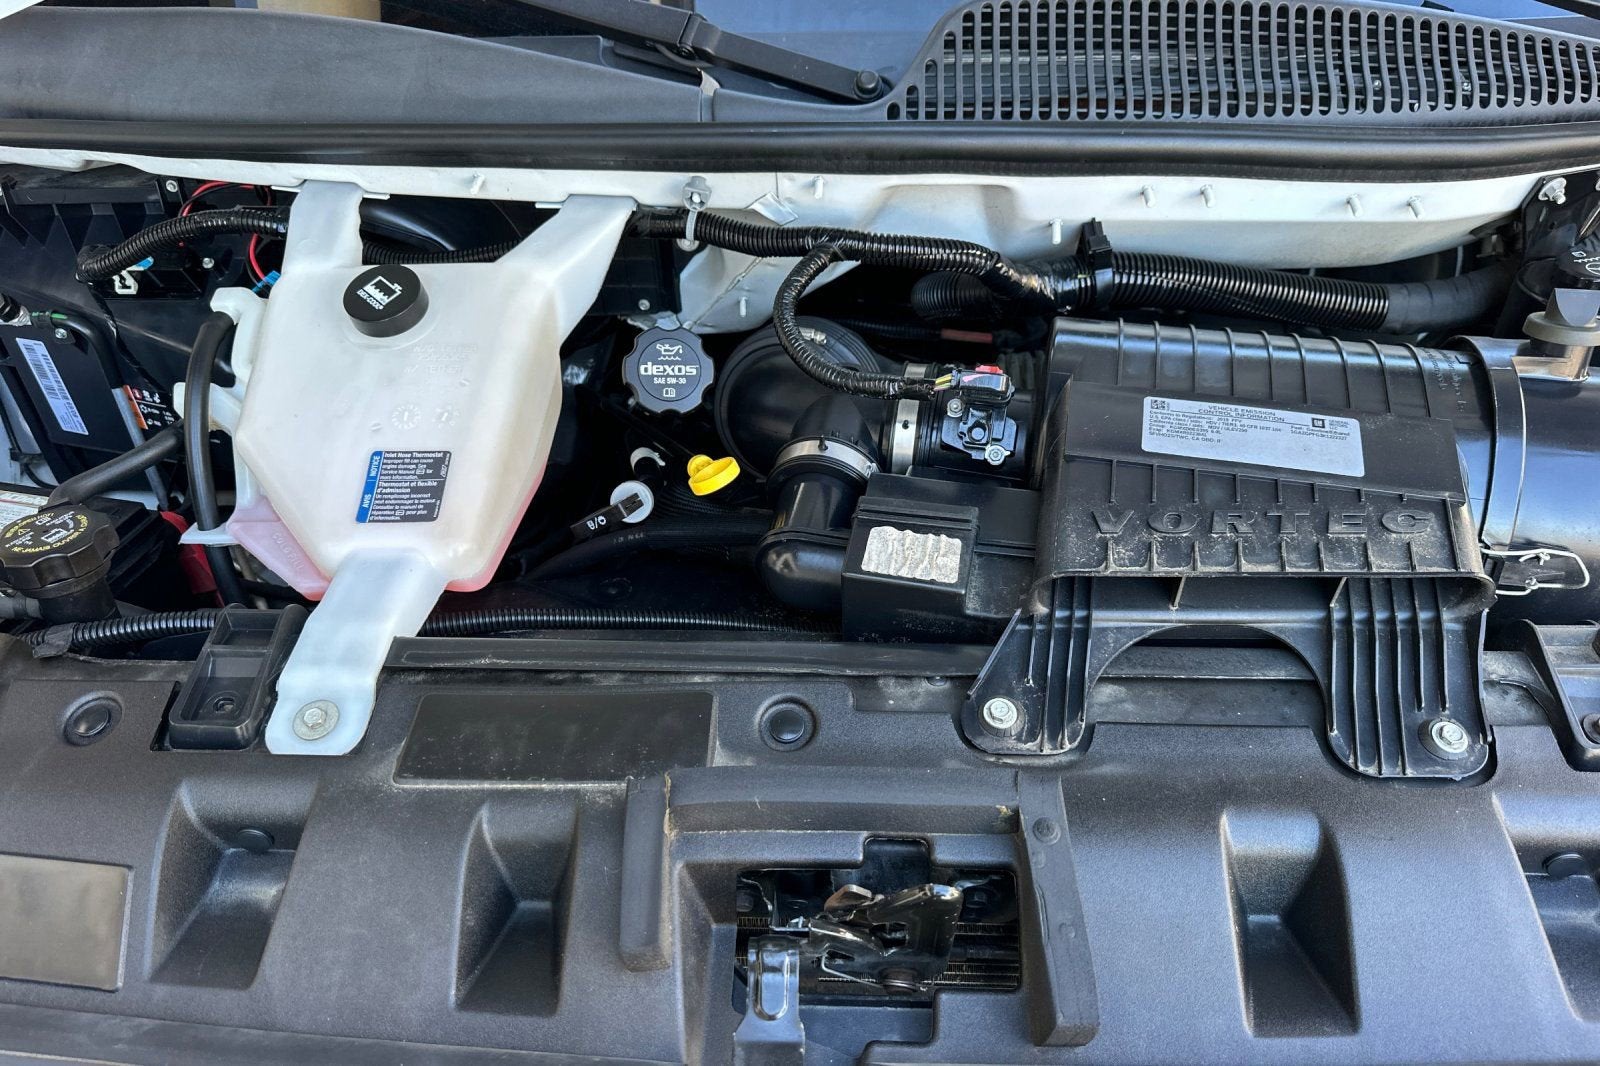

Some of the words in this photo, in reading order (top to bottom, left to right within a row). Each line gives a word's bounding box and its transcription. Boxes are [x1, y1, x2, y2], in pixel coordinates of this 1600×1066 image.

[640, 362, 696, 375] dexos
[1235, 413, 1284, 422] INFORMATION
[369, 456, 380, 476] NOTICE
[362, 494, 371, 508] AVIS
[1091, 509, 1435, 536] VORTEC
